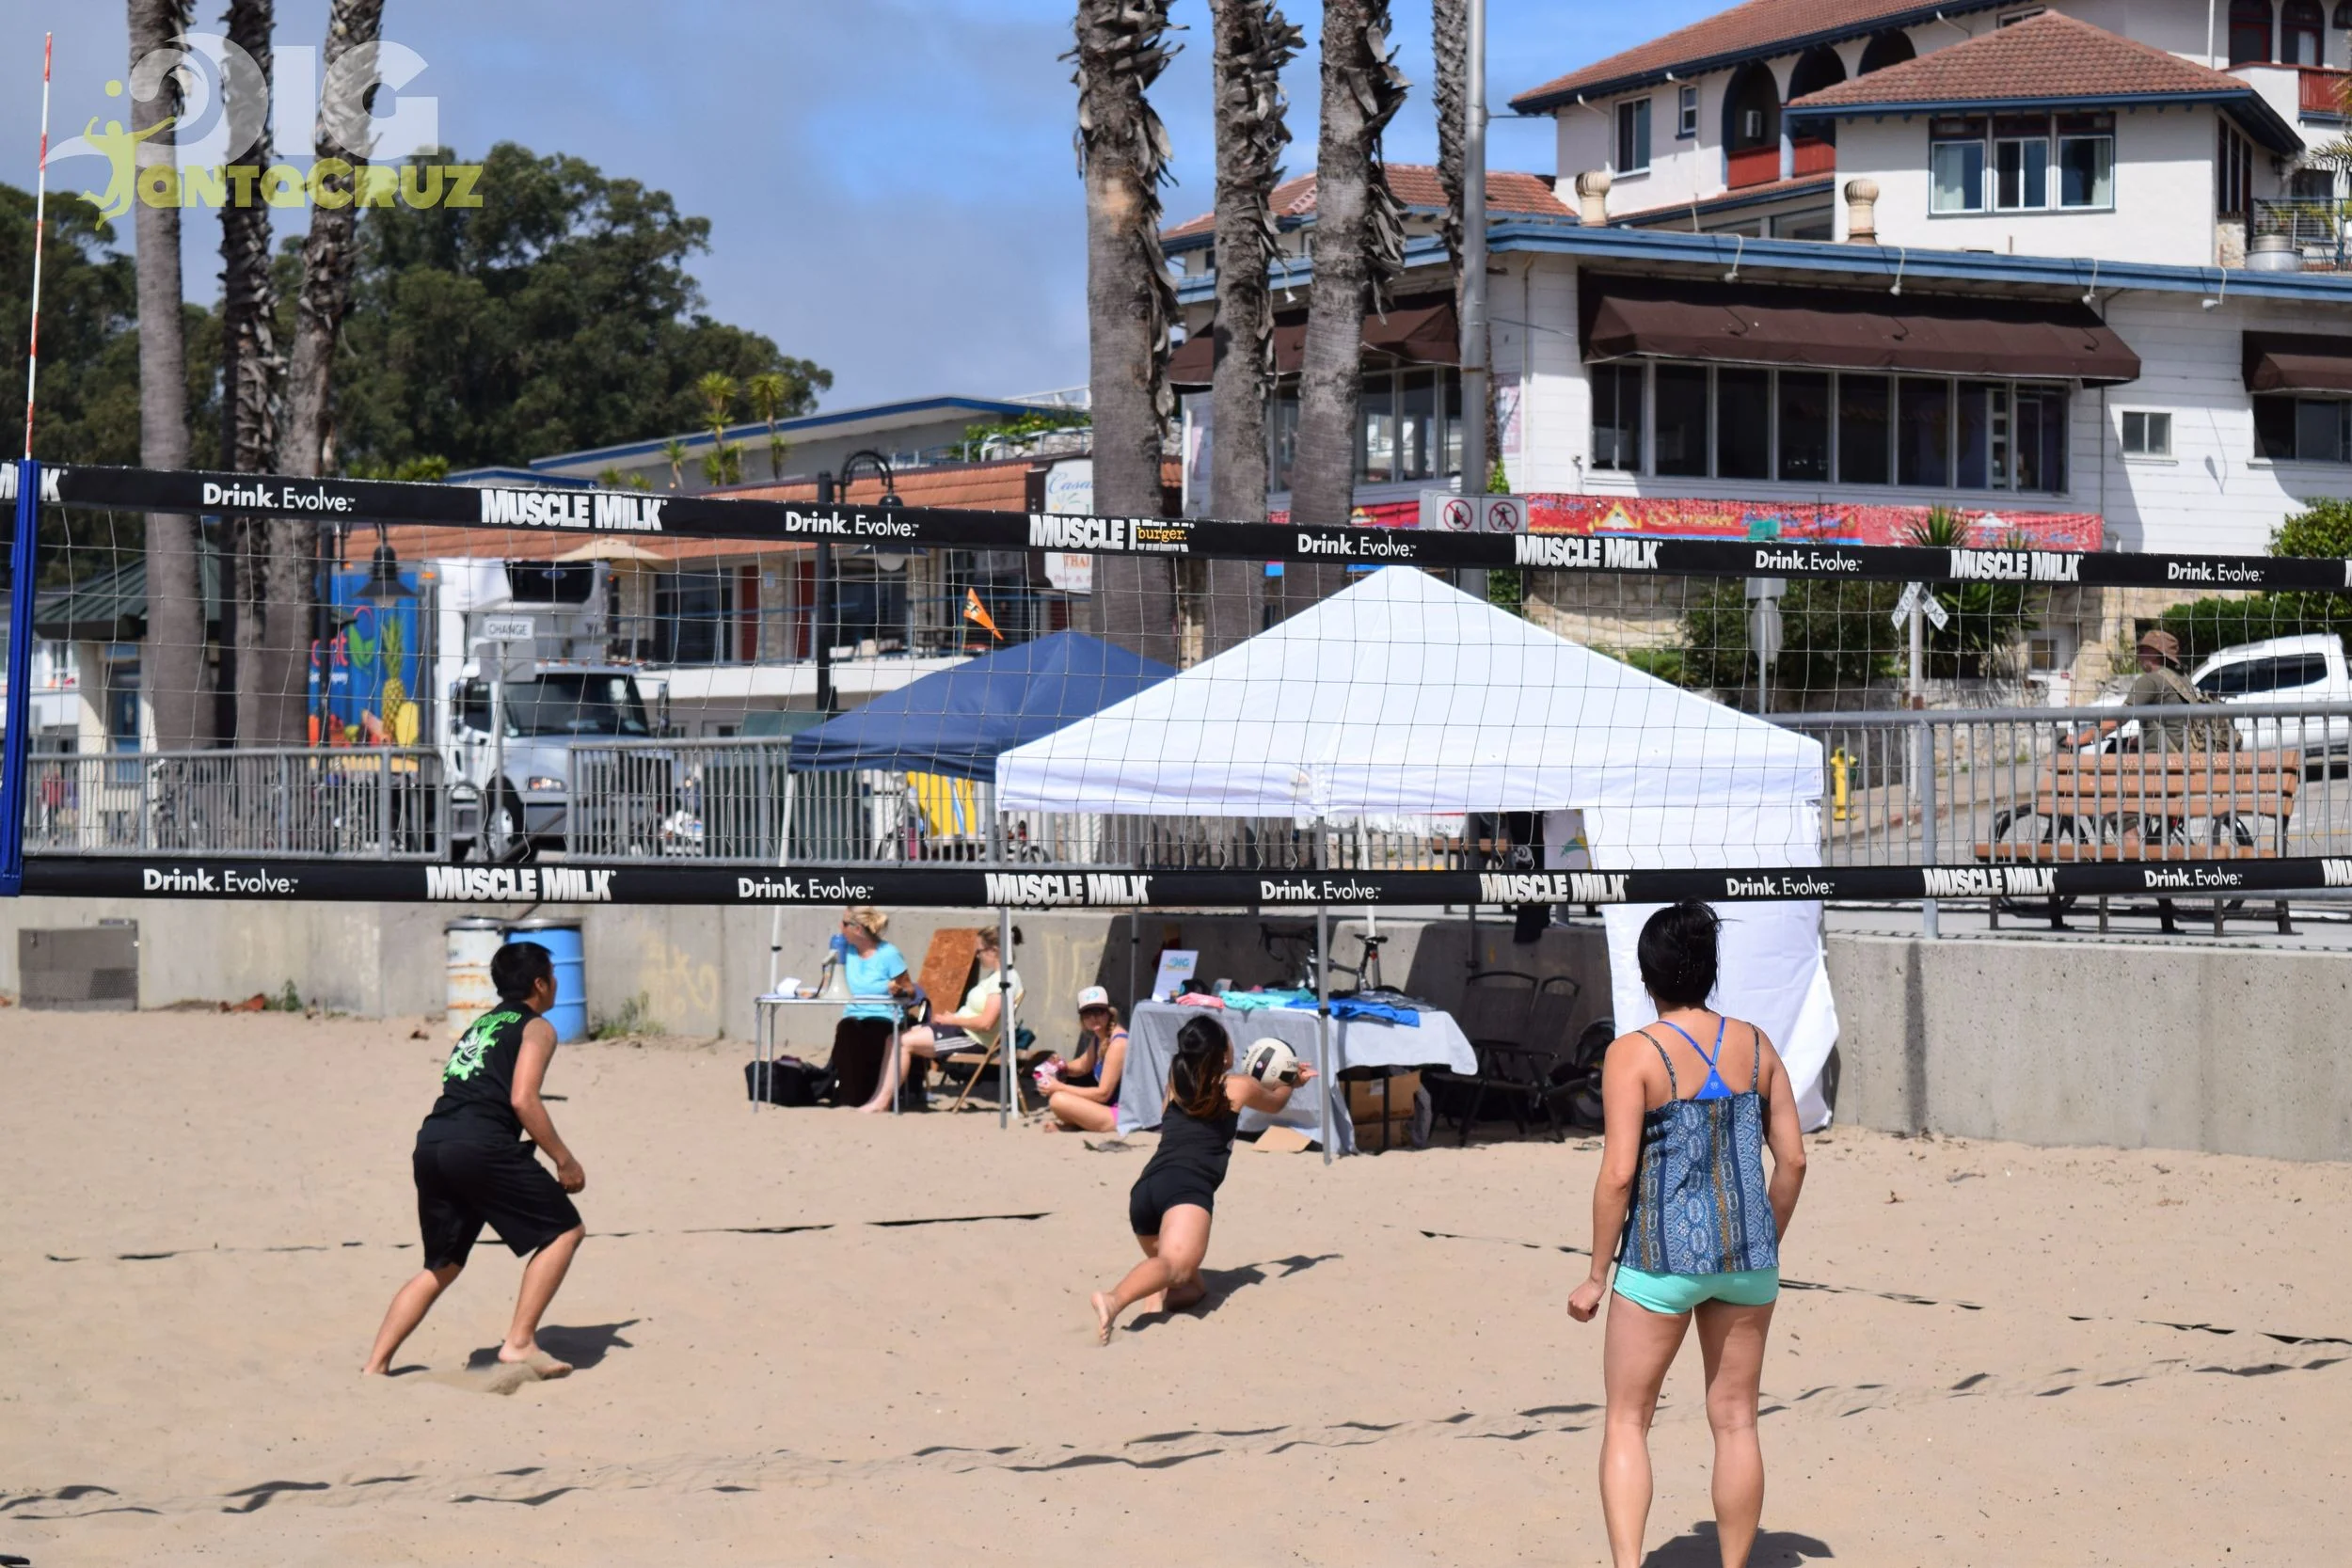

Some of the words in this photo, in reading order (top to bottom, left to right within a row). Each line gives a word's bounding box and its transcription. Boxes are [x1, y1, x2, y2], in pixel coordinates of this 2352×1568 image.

[203, 483, 278, 508] Drink.
[481, 488, 590, 528] MUSCLE
[595, 494, 662, 531] MILK
[786, 512, 851, 535] Drink.
[1029, 515, 1125, 549] MUSCLE
[1136, 527, 1187, 543] burger.
[1297, 533, 1357, 555] Drink.
[1516, 534, 1600, 567] MUSCLE
[1604, 539, 1658, 569] MILK
[1756, 550, 1808, 570] Drink.
[1950, 549, 2026, 579] MUSCLE
[2030, 551, 2079, 581] MILK
[2168, 562, 2215, 581] Drink.
[144, 868, 220, 892] Drink.
[426, 866, 536, 900] MUSCLE
[541, 867, 612, 901] MILK
[739, 877, 805, 898] Drink.
[985, 873, 1083, 904] MUSCLE
[1088, 874, 1149, 904] MILK
[1480, 874, 1567, 903] MUSCLE
[1571, 873, 1626, 902] MILK
[1726, 877, 1780, 895] Drink.
[1922, 868, 2003, 896] MUSCLE
[2006, 867, 2054, 895] MILK
[2144, 868, 2194, 887] Drink.
[1261, 880, 1321, 900] Drink.
